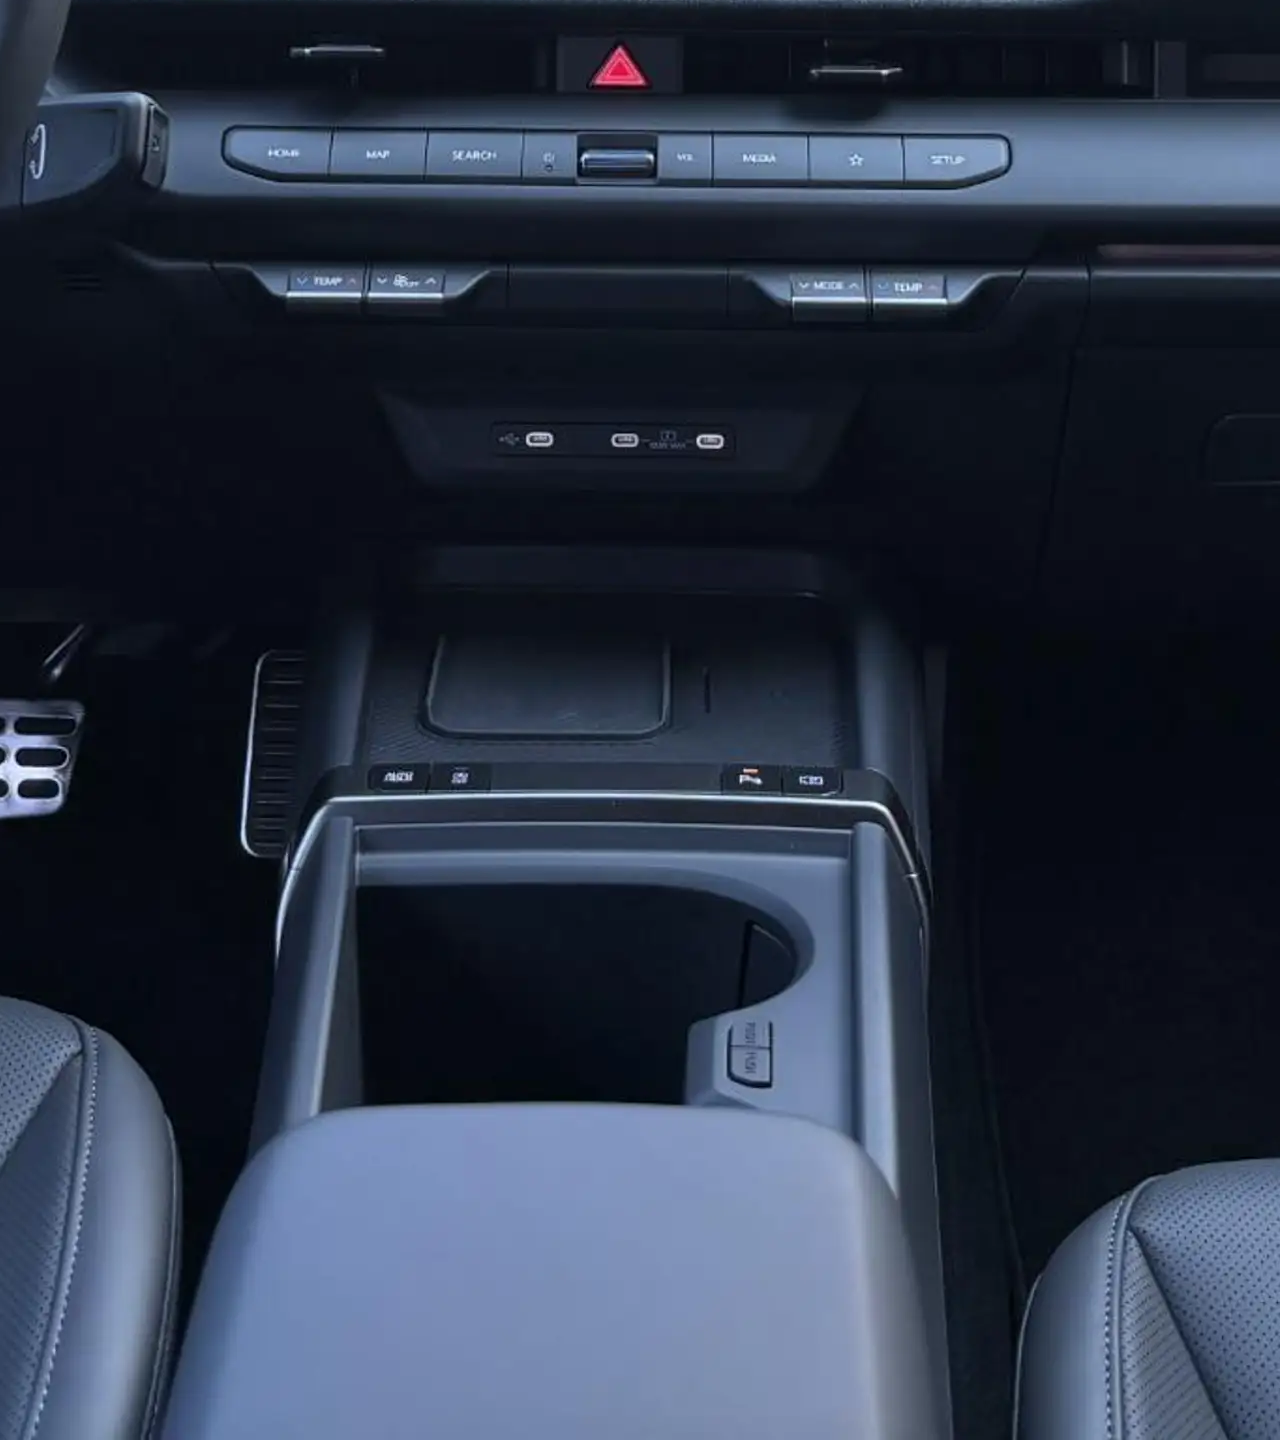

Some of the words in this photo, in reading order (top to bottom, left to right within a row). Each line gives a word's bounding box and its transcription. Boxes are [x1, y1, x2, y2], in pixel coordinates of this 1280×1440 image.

[268, 148, 301, 158] HOME
[366, 149, 391, 159] MAP
[452, 149, 497, 161] SEARCH
[742, 152, 777, 164] MEDIA
[930, 154, 966, 165] SETUP
[894, 281, 923, 293] TEMP
